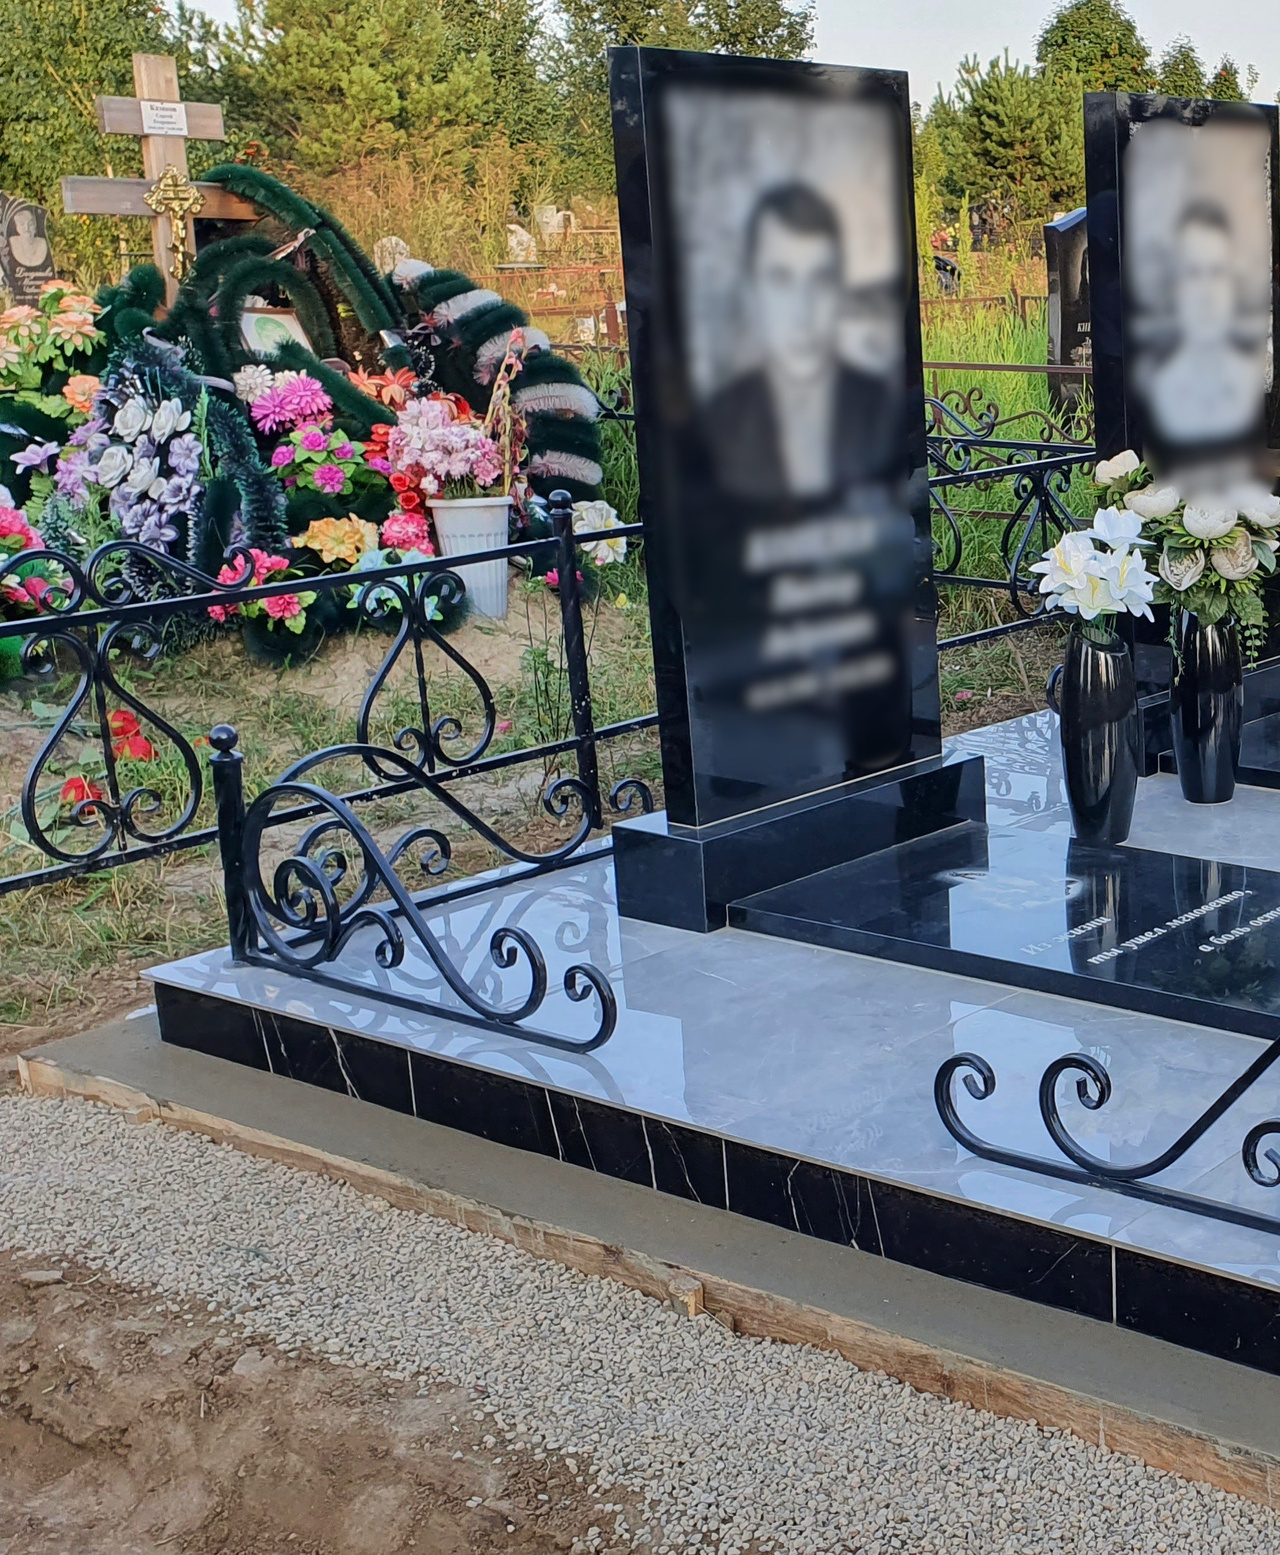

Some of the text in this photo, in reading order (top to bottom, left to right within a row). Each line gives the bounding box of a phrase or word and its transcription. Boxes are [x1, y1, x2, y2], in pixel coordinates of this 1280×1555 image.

[1020, 916, 1112, 956] Из жизни
[1087, 890, 1253, 965] ты ушел мгновенно,
[1198, 944, 1215, 953] а
[1209, 926, 1251, 945] боль
